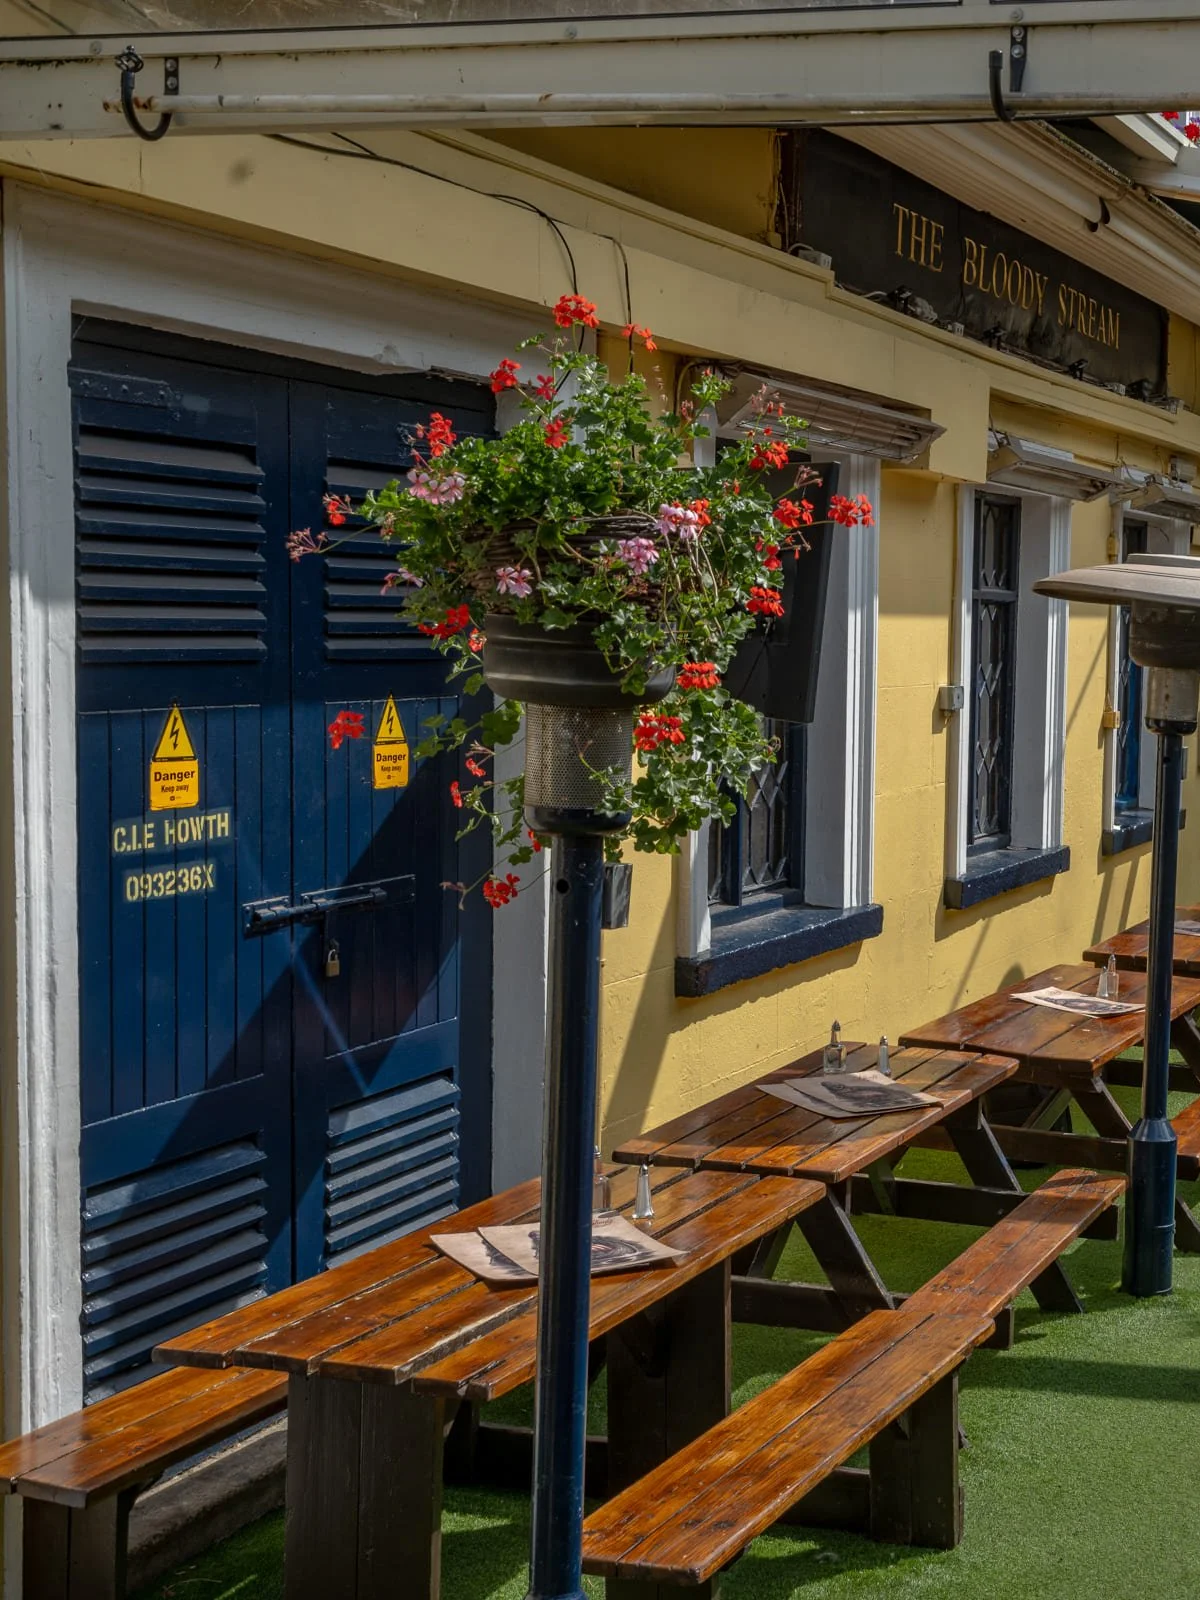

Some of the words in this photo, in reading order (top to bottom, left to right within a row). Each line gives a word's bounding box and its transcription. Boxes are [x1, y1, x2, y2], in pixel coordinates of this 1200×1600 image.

[893, 203, 944, 273] THE
[963, 237, 1049, 317] BLOODY
[1057, 283, 1121, 350] STREAM
[376, 753, 406, 764] Danger
[154, 770, 196, 782] Danger
[161, 784, 175, 794] Keep
[176, 783, 190, 793] away
[164, 812, 229, 845] HOWTH
[126, 863, 215, 901] 093236X
